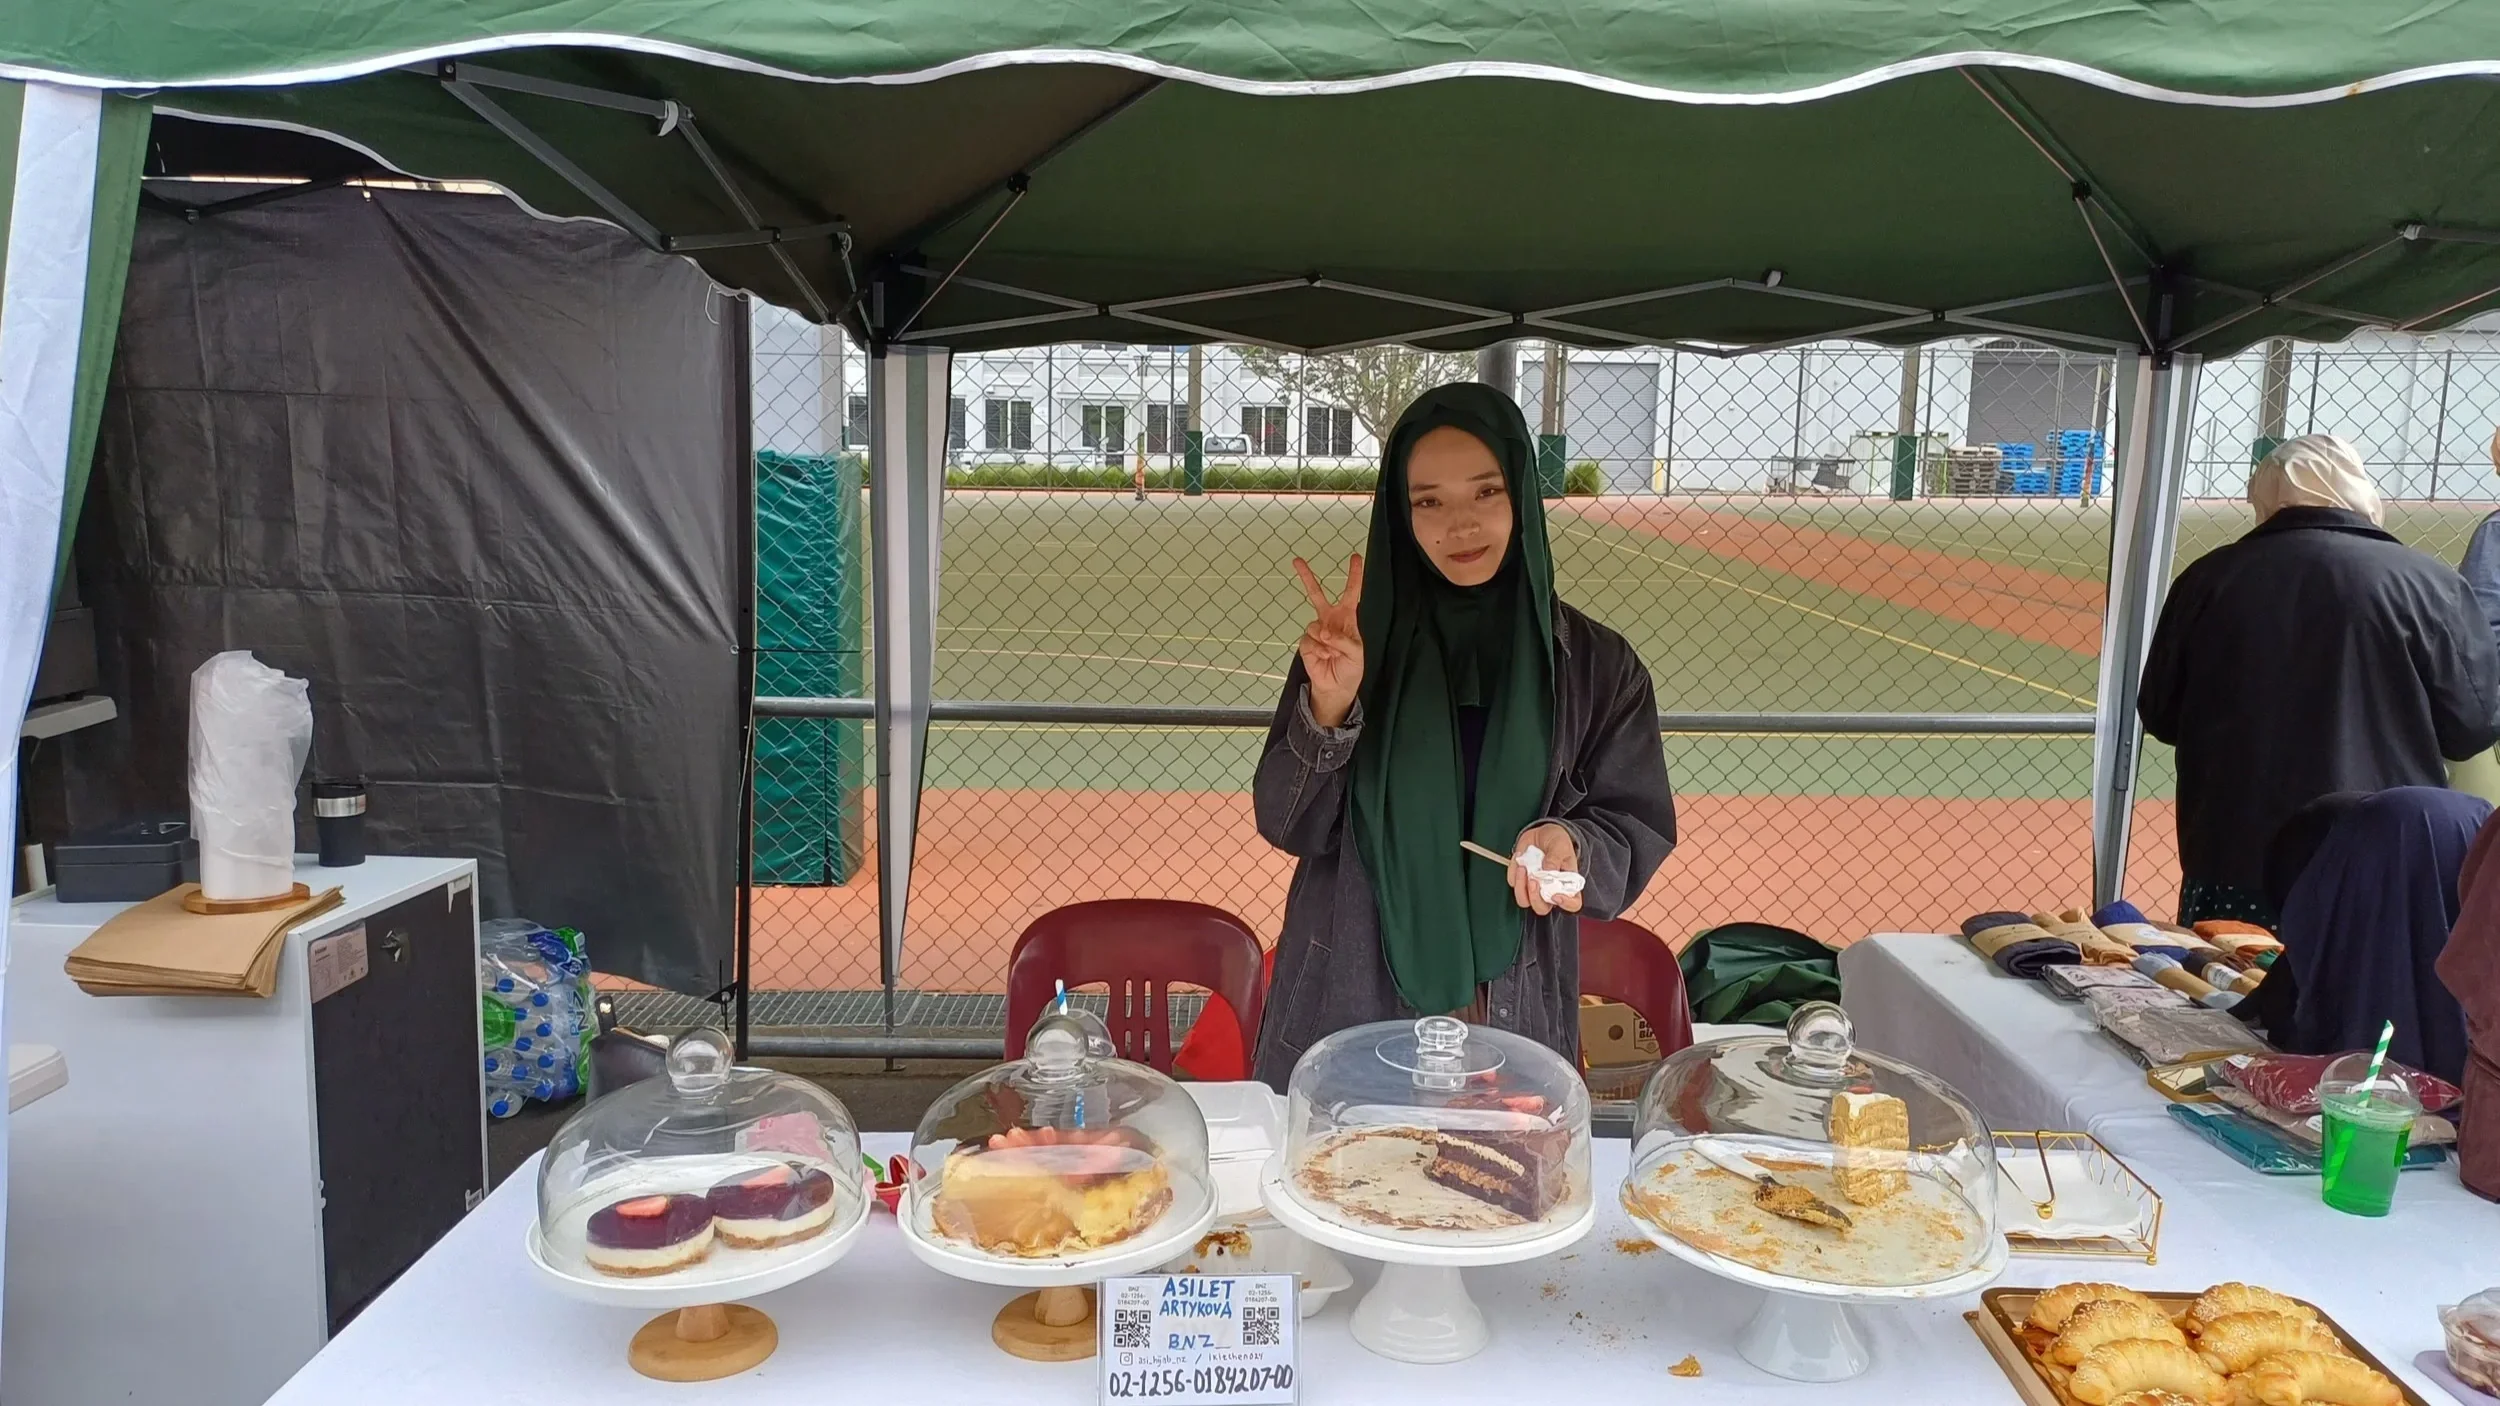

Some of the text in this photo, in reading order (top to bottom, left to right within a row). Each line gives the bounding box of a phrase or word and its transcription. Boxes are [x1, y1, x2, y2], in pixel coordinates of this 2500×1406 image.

[1162, 1276, 1235, 1300] ASILET
[1159, 1299, 1232, 1319] ARTYKOVA
[1168, 1333, 1214, 1349] BNZ
[1109, 1364, 1293, 1398] 02-1256-0184207-00
